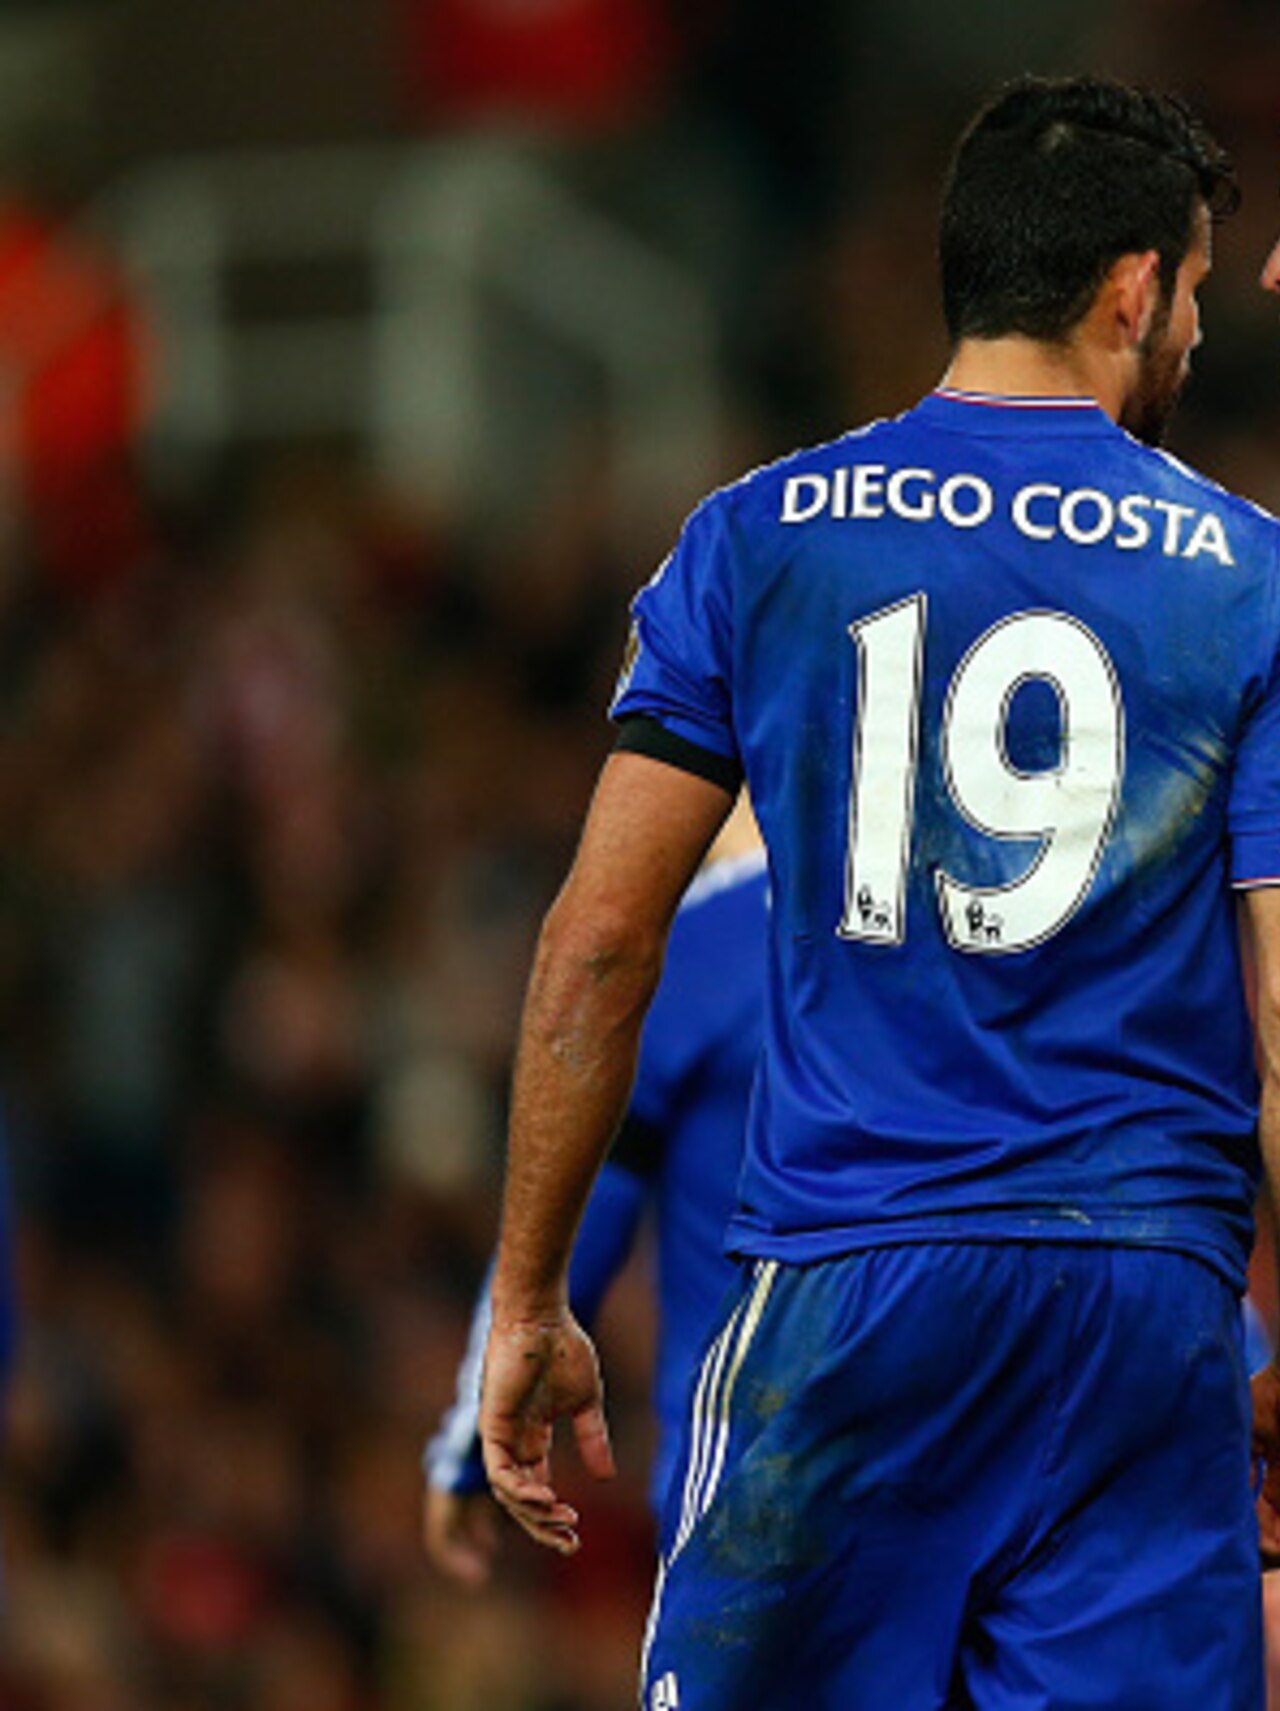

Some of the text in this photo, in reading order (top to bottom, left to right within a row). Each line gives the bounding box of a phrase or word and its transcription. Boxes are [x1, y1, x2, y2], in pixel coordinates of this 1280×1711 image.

[780, 464, 1235, 566] DIEGO COSTA
[836, 590, 1126, 953] 19
